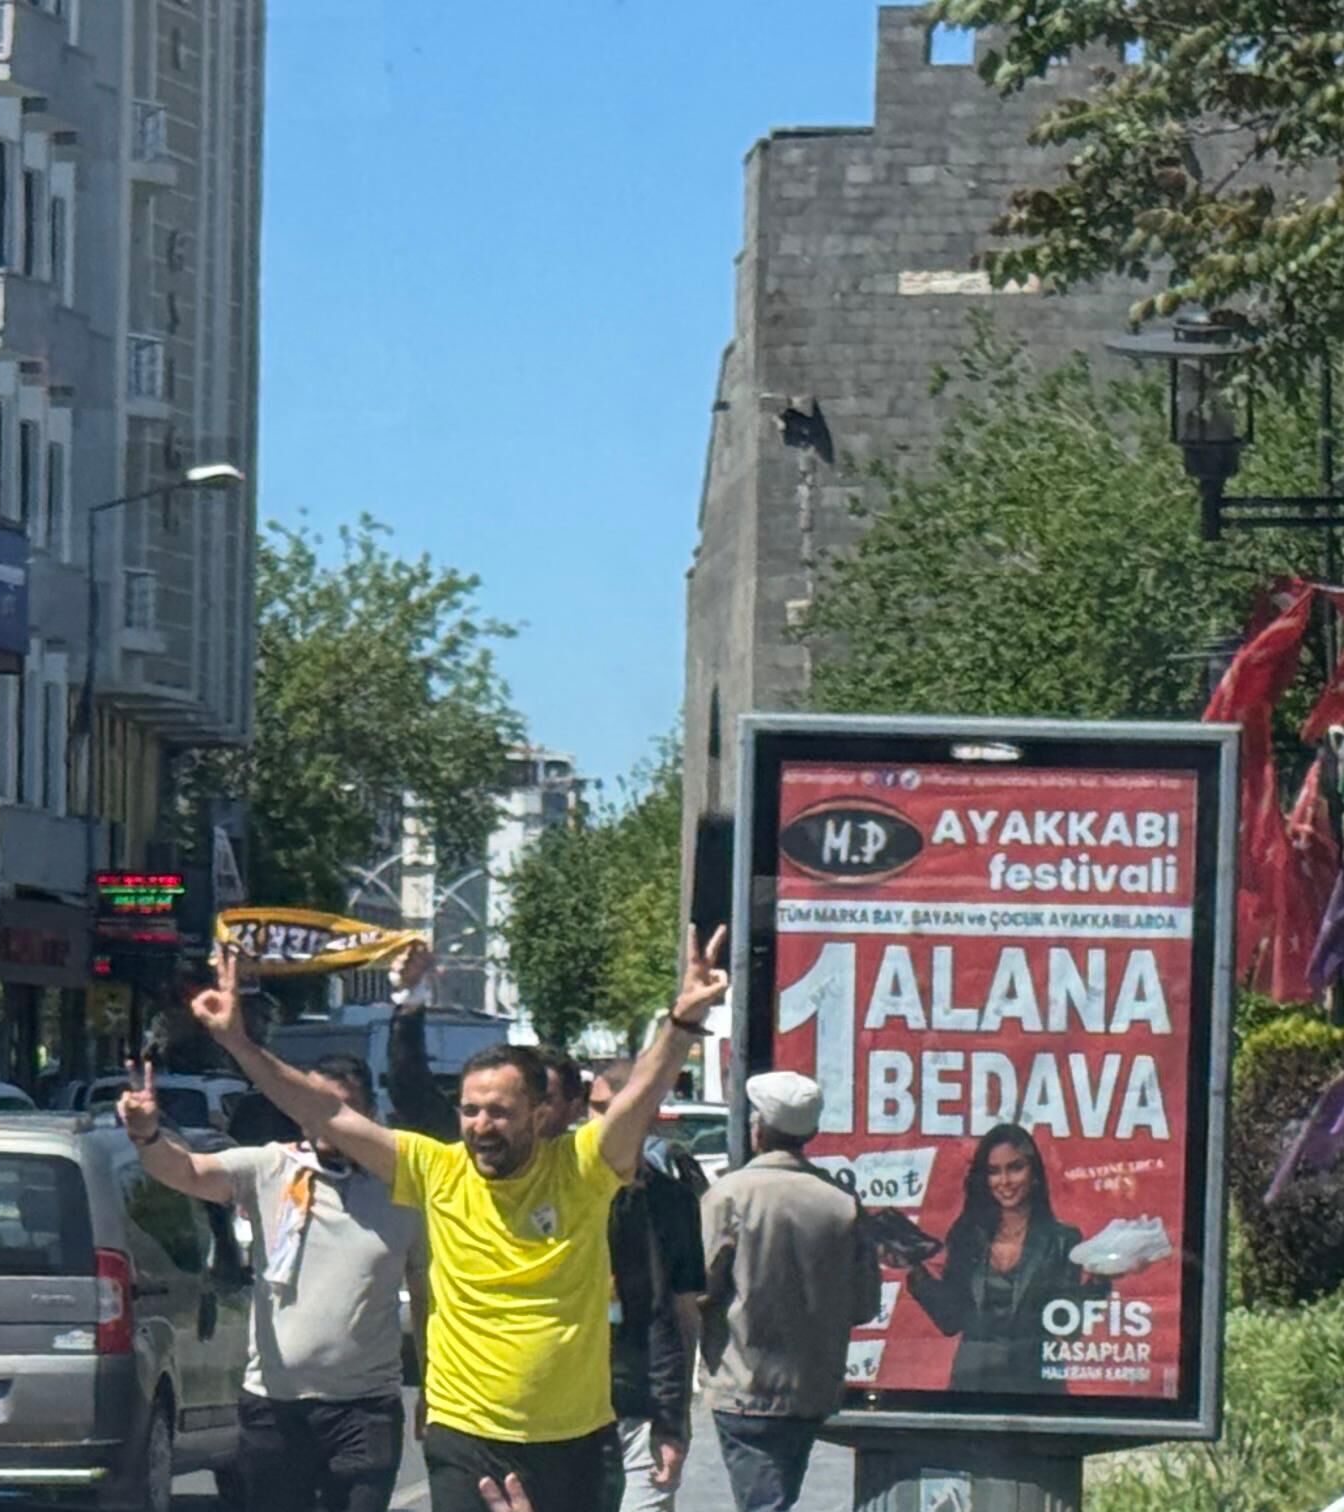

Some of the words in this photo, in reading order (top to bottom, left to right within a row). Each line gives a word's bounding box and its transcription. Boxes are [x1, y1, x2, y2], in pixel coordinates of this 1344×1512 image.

[931, 809, 1179, 848] AYAKKABI
[988, 852, 1178, 894] festivali
[990, 910, 1045, 932] ÇOCUK
[778, 942, 856, 1133] 1
[863, 944, 1173, 1034] ALANA
[865, 1049, 1170, 1140] BEDAVA
[1042, 1291, 1153, 1337] OFİS
[1041, 1341, 1152, 1362] KASAPLAR
